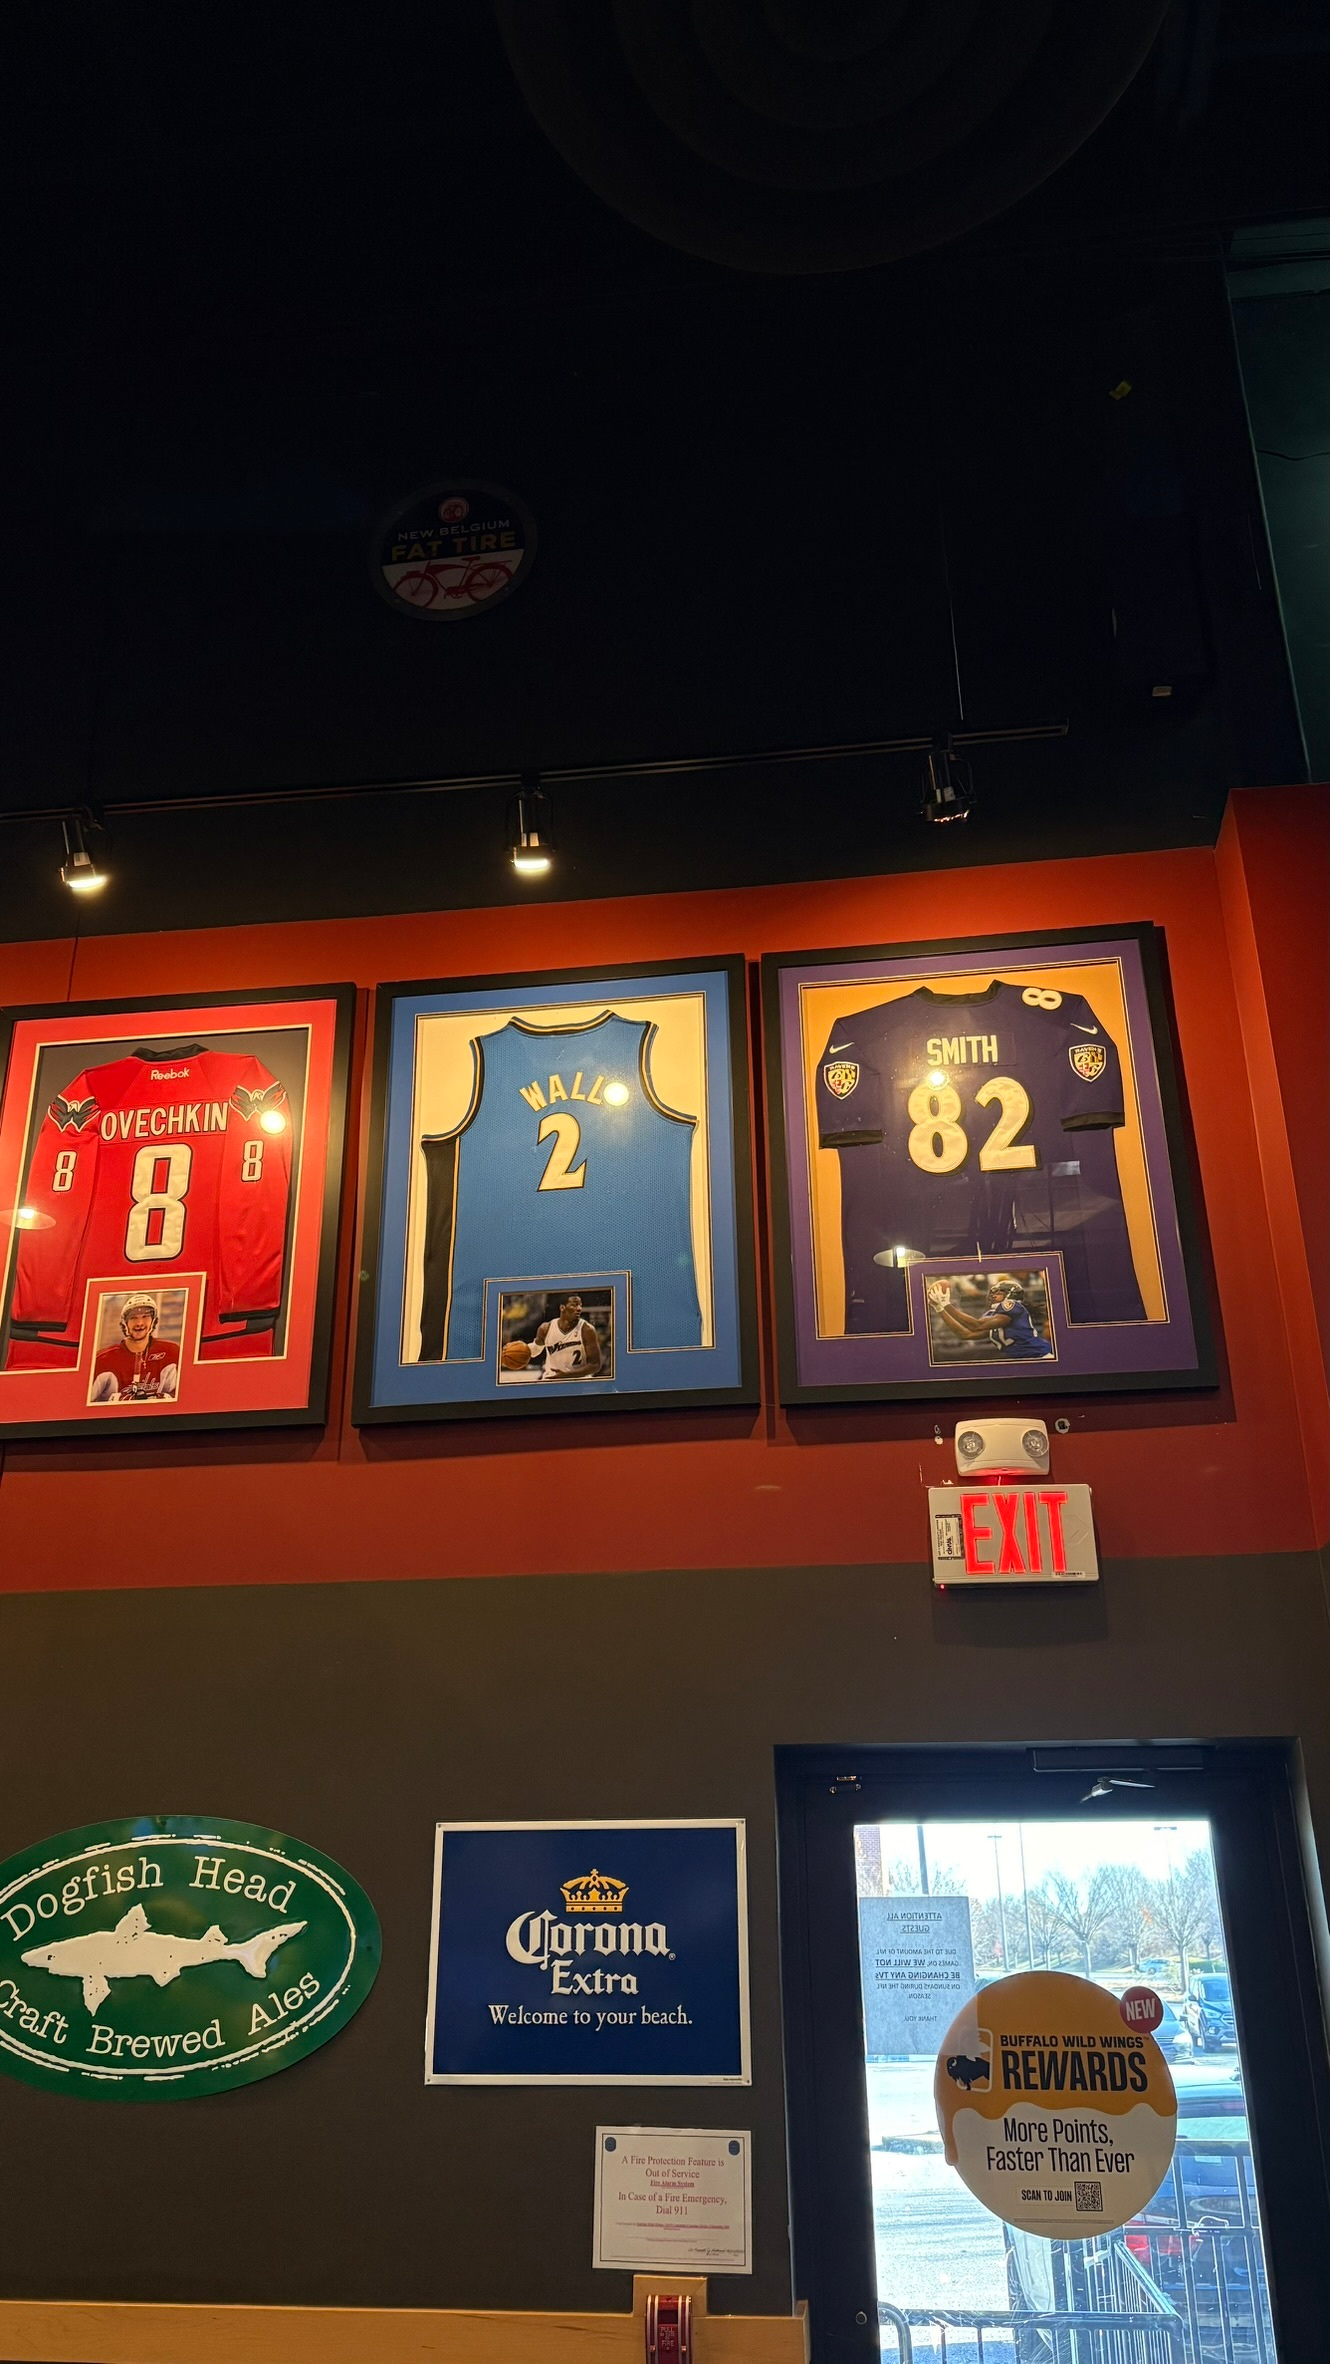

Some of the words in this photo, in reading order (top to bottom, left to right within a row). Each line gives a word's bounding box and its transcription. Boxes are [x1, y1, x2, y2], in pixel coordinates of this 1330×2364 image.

[391, 540, 442, 561] FAT
[452, 531, 516, 553] TIRE
[398, 529, 434, 541] NEW
[440, 519, 510, 536] BELGIUM
[926, 1034, 999, 1067] SMITH
[150, 1067, 190, 1081] Reebok
[518, 1071, 606, 1112] WALL
[101, 1101, 229, 1141] OVECHKIN
[907, 1075, 1040, 1175] 82
[241, 1139, 264, 1182] 8
[537, 1112, 587, 1192] 2
[52, 1150, 77, 1192] 8
[124, 1143, 192, 1262] 8
[572, 1350, 582, 1366] 2
[960, 1492, 1068, 1574] EXIT
[1, 1857, 163, 1941] Dogfish
[189, 1856, 296, 1913] Head
[506, 1909, 671, 1971] Corona
[551, 1959, 639, 1995] Extra
[0, 1979, 69, 2044] Craft
[86, 2019, 225, 2058] Brewed
[248, 1971, 321, 2036] Ales
[488, 2004, 568, 2025] Welcome
[573, 2010, 591, 2025] to
[595, 2011, 637, 2032] your
[641, 2004, 693, 2025] beach.
[1125, 1998, 1156, 2021] NEW
[1000, 2035, 1058, 2047] BUFFALO
[1062, 2036, 1096, 2048] WILD
[1099, 2036, 1144, 2049] WINGS
[1002, 2050, 1148, 2092] REWARDS
[1004, 2117, 1048, 2143] More
[1053, 2118, 1113, 2147] Points,
[622, 2156, 628, 2164] A
[630, 2155, 646, 2165] Fire
[648, 2156, 686, 2166] Protection
[688, 2157, 716, 2166] Feature
[718, 2158, 724, 2167] is
[646, 2168, 660, 2177] Out
[662, 2168, 670, 2177] of
[672, 2169, 700, 2179] Service
[986, 2146, 1044, 2172] Faster
[1048, 2147, 1091, 2173] Than
[1095, 2148, 1135, 2173] Ever
[618, 2192, 626, 2200] In
[628, 2192, 646, 2201] Case
[648, 2192, 657, 2202] of
[658, 2194, 662, 2202] a
[665, 2193, 680, 2202] Fire
[682, 2193, 727, 2206] Emergency,
[656, 2205, 672, 2215] Dial
[674, 2206, 688, 2215] 911
[1022, 2189, 1041, 2201] SCAN
[1043, 2190, 1052, 2201] TO
[1055, 2190, 1072, 2202] JOIN
